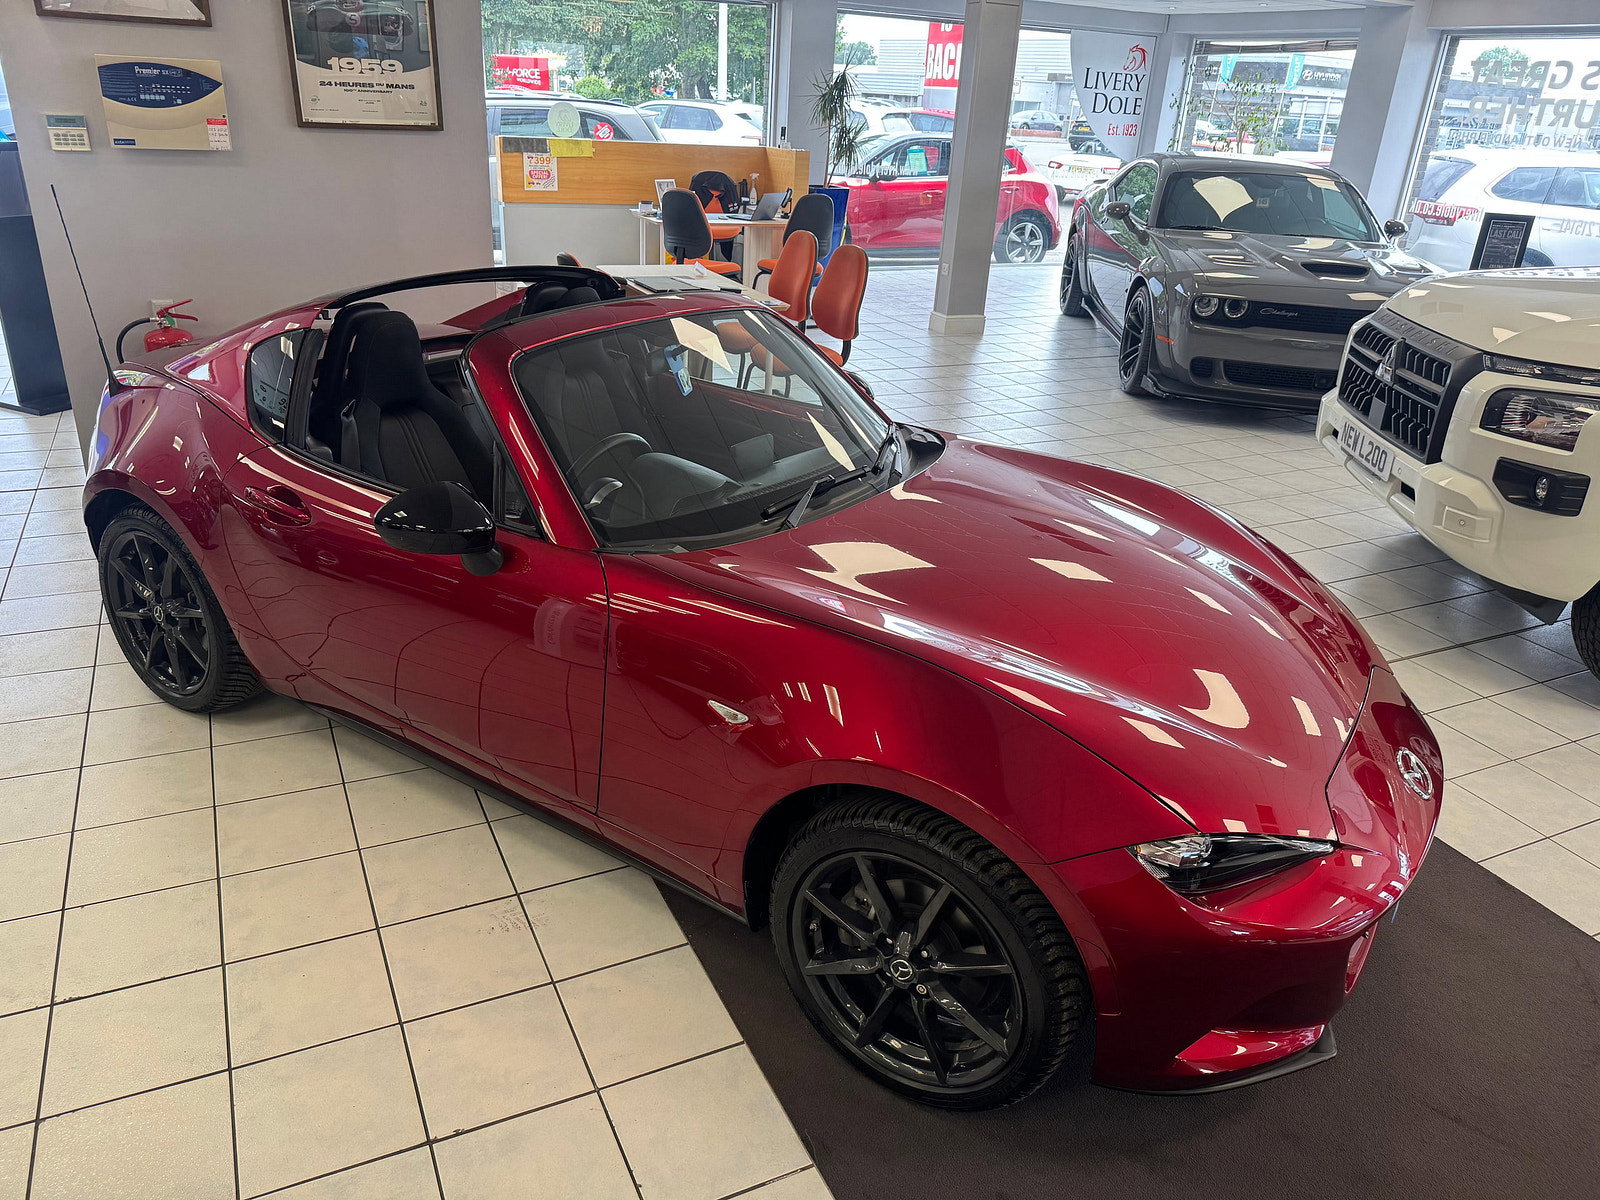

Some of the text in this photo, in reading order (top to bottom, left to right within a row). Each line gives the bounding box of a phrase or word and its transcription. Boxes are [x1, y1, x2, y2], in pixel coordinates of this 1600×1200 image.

[135, 66, 160, 75] Premier
[327, 57, 403, 75] 1959
[1083, 67, 1147, 92] LIVERY
[1313, 72, 1342, 82] HYUNDAI
[319, 80, 334, 88] 24
[334, 81, 375, 89] HEURES
[1091, 92, 1142, 115] DOLE
[1107, 123, 1138, 136] Est. 1923
[1489, 228, 1522, 239] LAST CALL
[1340, 421, 1388, 473] NEW L200
